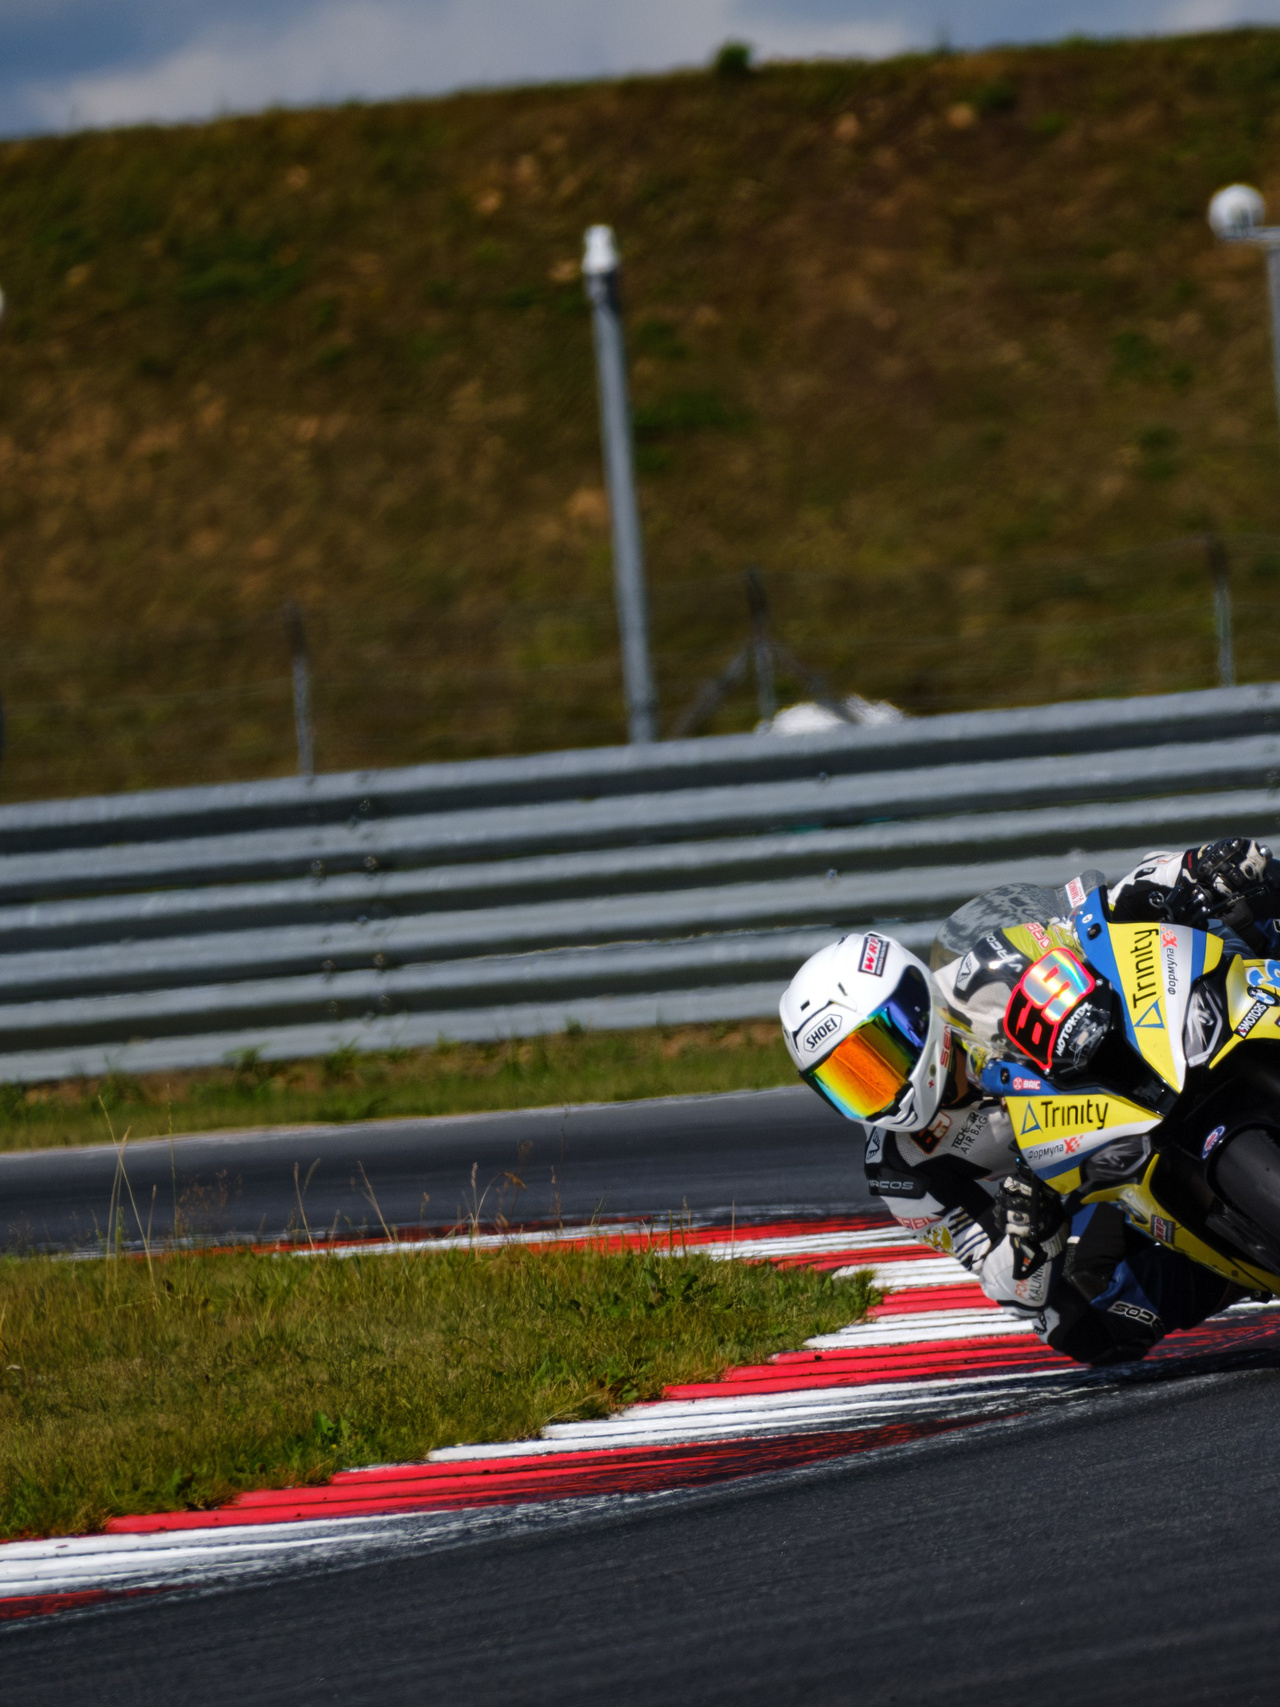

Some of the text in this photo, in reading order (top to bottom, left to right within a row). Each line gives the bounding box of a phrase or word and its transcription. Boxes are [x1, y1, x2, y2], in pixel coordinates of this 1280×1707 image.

[1130, 928, 1159, 1009] Trinity
[806, 1017, 838, 1049] SHOEI
[1041, 1099, 1108, 1130] Trinity
[959, 1115, 989, 1154] AIR BAG
